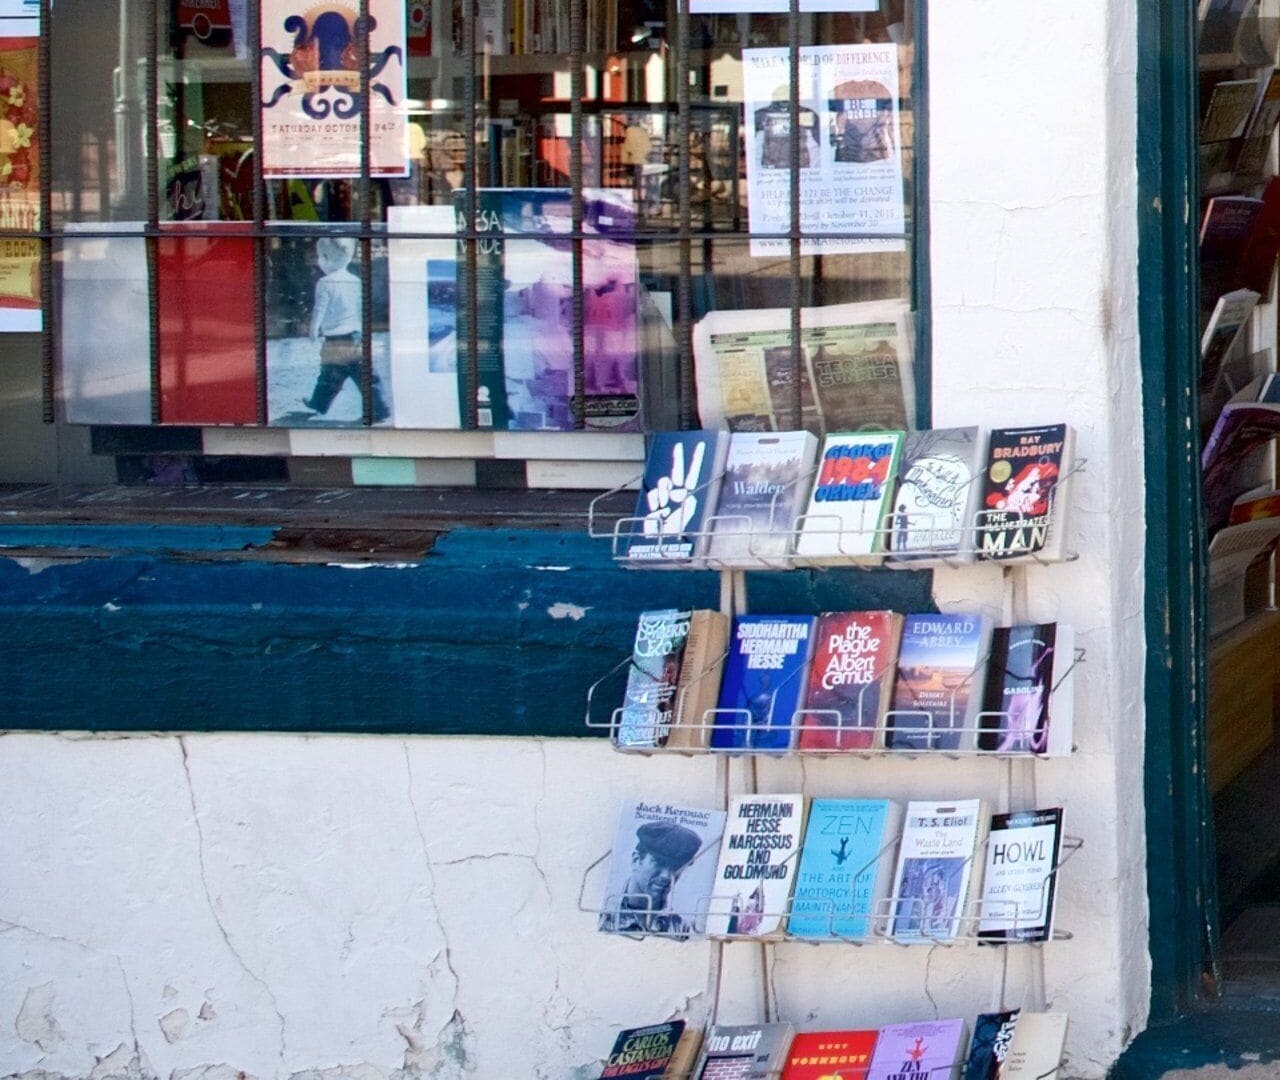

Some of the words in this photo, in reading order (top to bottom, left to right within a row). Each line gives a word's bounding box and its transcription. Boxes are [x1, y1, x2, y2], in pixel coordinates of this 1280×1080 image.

[836, 51, 890, 65] DIFFERENCE
[325, 123, 358, 132] OCTOB
[834, 187, 851, 197] THE
[854, 185, 894, 196] CHANGE
[816, 355, 895, 372] TEQUILA
[820, 368, 897, 386] SUNRISE
[1020, 436, 1041, 444] RAY
[825, 443, 893, 460] GEORGE
[993, 442, 1063, 458] BRADBURY
[818, 456, 891, 487] 1984
[734, 481, 784, 495] Walden
[986, 512, 1007, 522] THE
[983, 527, 1046, 555] MAN
[738, 622, 808, 638] SIDDHARTHA
[846, 621, 872, 640] the
[913, 621, 974, 634] EDWARD
[740, 639, 798, 654] HERMANN
[829, 635, 880, 657] Plague
[919, 636, 962, 647] ABBEY
[748, 654, 785, 669] HESSE
[825, 653, 876, 671] Albert
[822, 670, 873, 690] Camus
[636, 802, 661, 812] Jack
[665, 806, 710, 820] Kerouac
[739, 803, 794, 818] HERMANN
[679, 816, 708, 827] Poems
[747, 819, 781, 833] HESSE
[820, 815, 873, 835] ZEN
[918, 818, 928, 827] T.
[930, 818, 940, 827] S.
[943, 816, 968, 827] Eliot
[729, 834, 792, 849] NARCISSUS
[746, 850, 771, 864] AND
[993, 840, 1046, 864] HOWL
[723, 864, 788, 879] GOLDMUND
[802, 873, 822, 883] THE
[829, 873, 850, 883] ART
[799, 887, 869, 898] MOTORCYCLE
[795, 902, 867, 913] MAINTENANCE
[624, 1032, 670, 1051] CARLOS
[709, 1035, 727, 1051] no
[731, 1030, 761, 1051] exit
[608, 1044, 673, 1066] CASTANEDA
[792, 1055, 867, 1065] VONNEGUT
